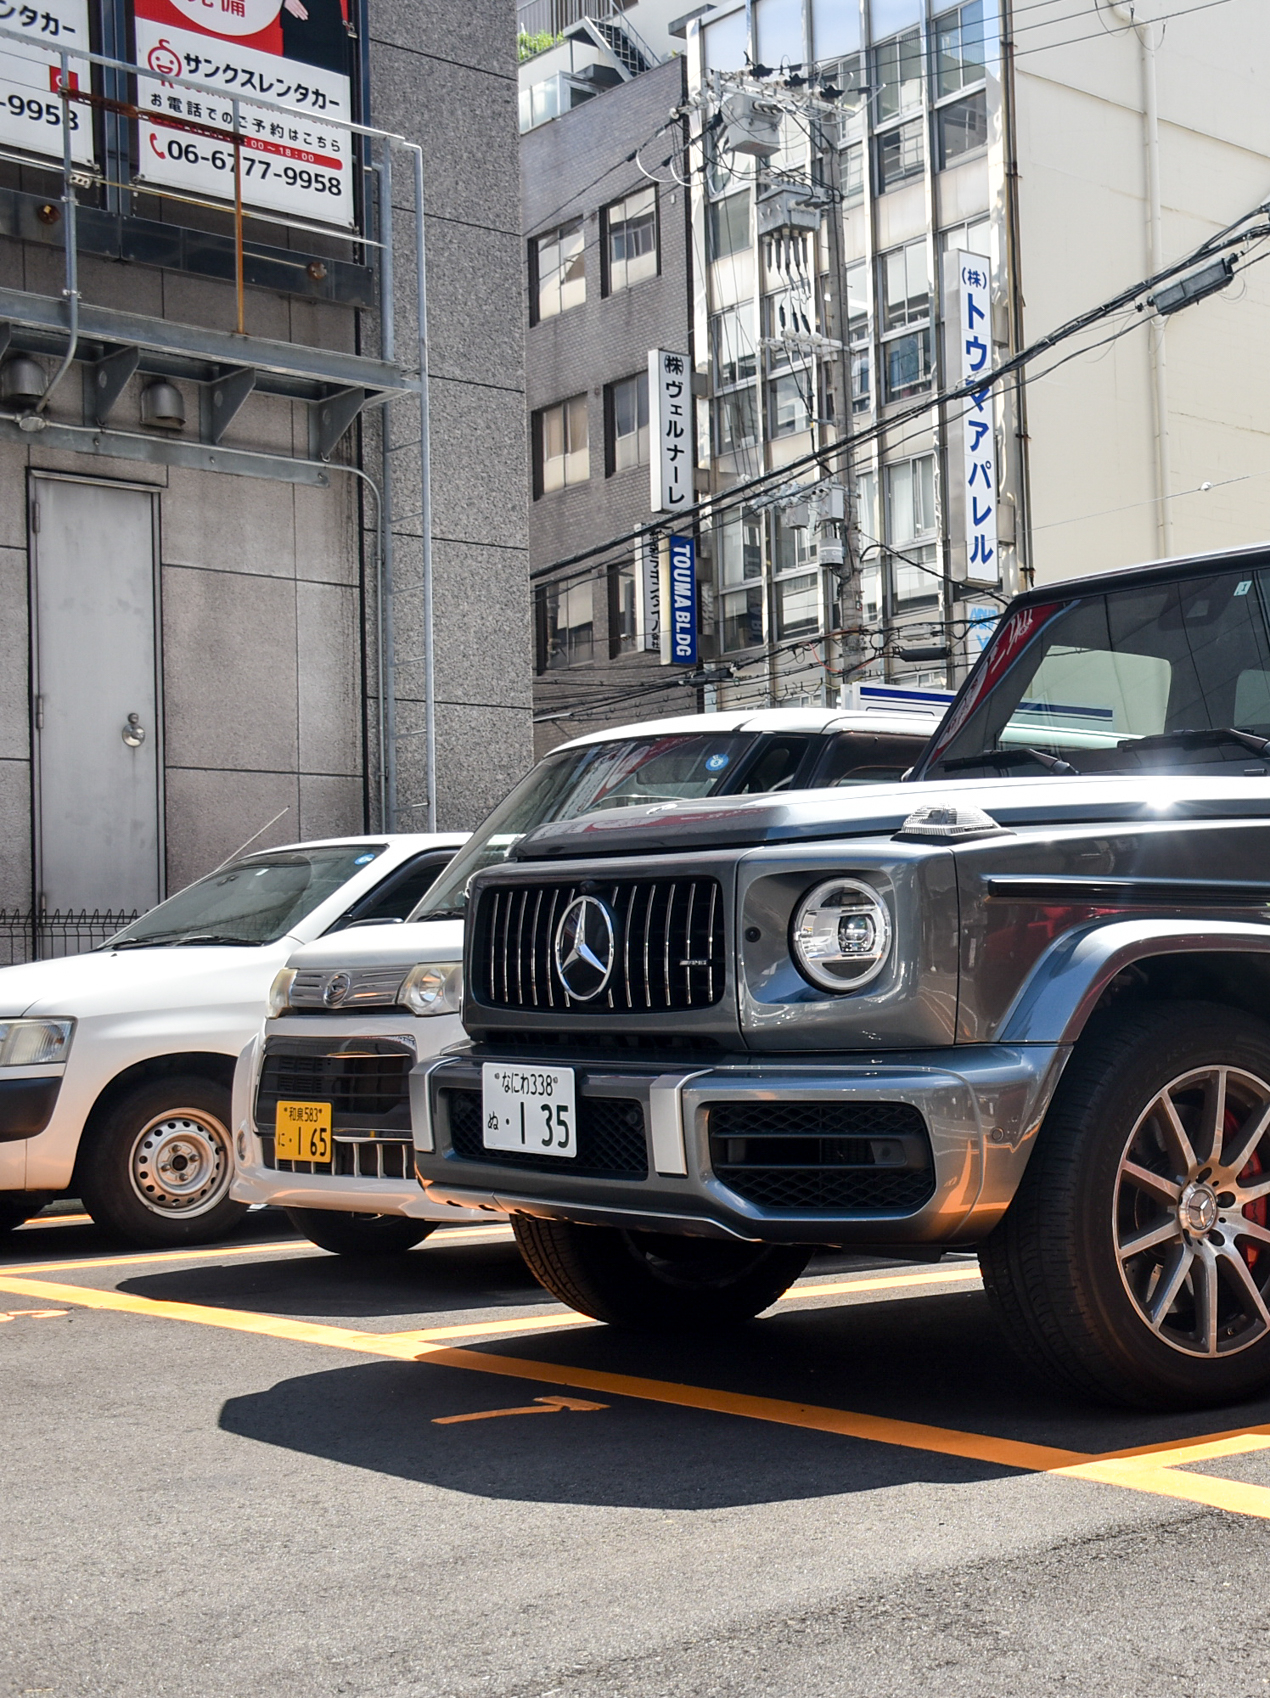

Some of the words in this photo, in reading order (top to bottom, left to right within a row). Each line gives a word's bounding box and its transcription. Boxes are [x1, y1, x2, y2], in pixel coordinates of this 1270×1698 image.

[184, 53, 341, 110] サンクスレンタカー
[673, 544, 692, 608] TOUMA
[674, 611, 692, 657] BLDG
